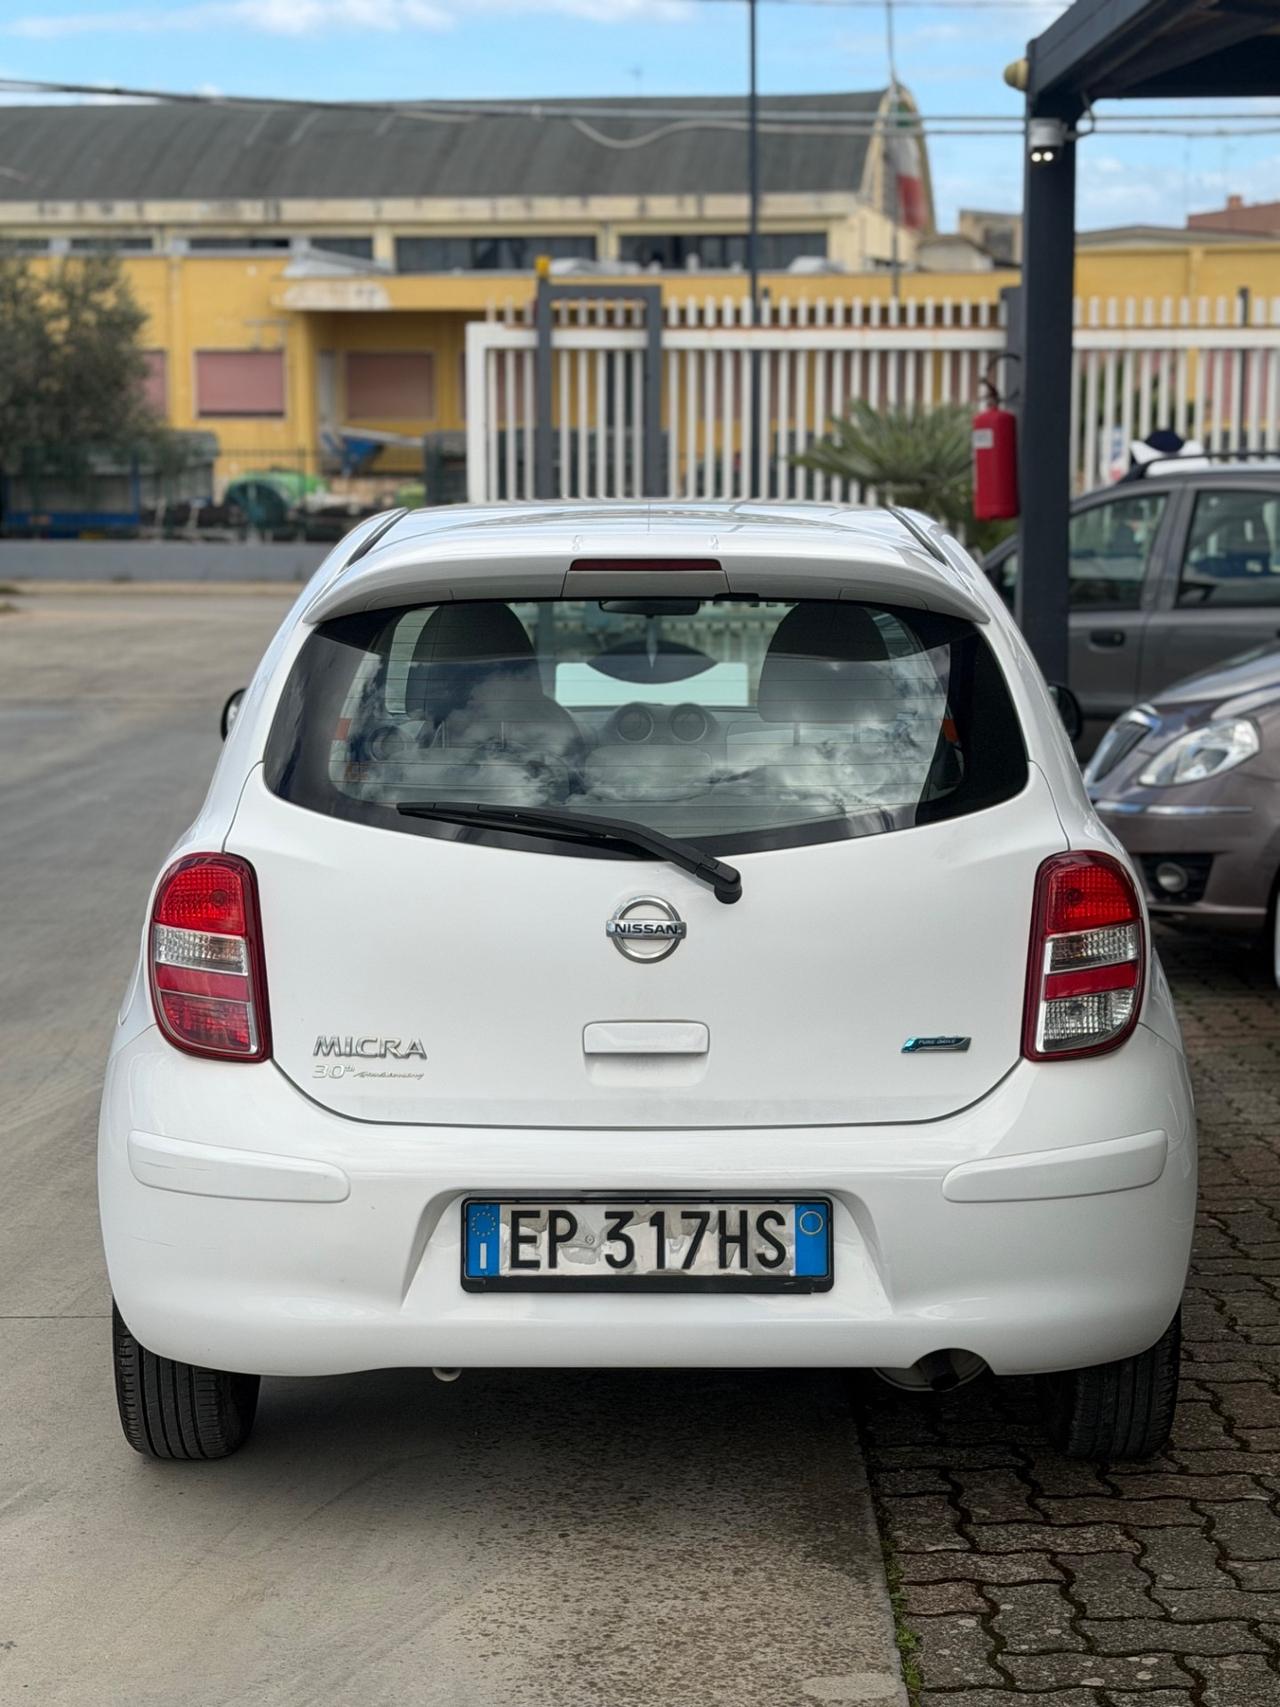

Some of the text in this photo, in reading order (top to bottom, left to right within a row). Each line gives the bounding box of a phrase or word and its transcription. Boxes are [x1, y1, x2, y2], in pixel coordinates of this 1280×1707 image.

[614, 923, 678, 935] NISSAN
[313, 1036, 427, 1060] MICRA
[510, 1210, 787, 1271] EP 317HS
[480, 1243, 487, 1269] I
